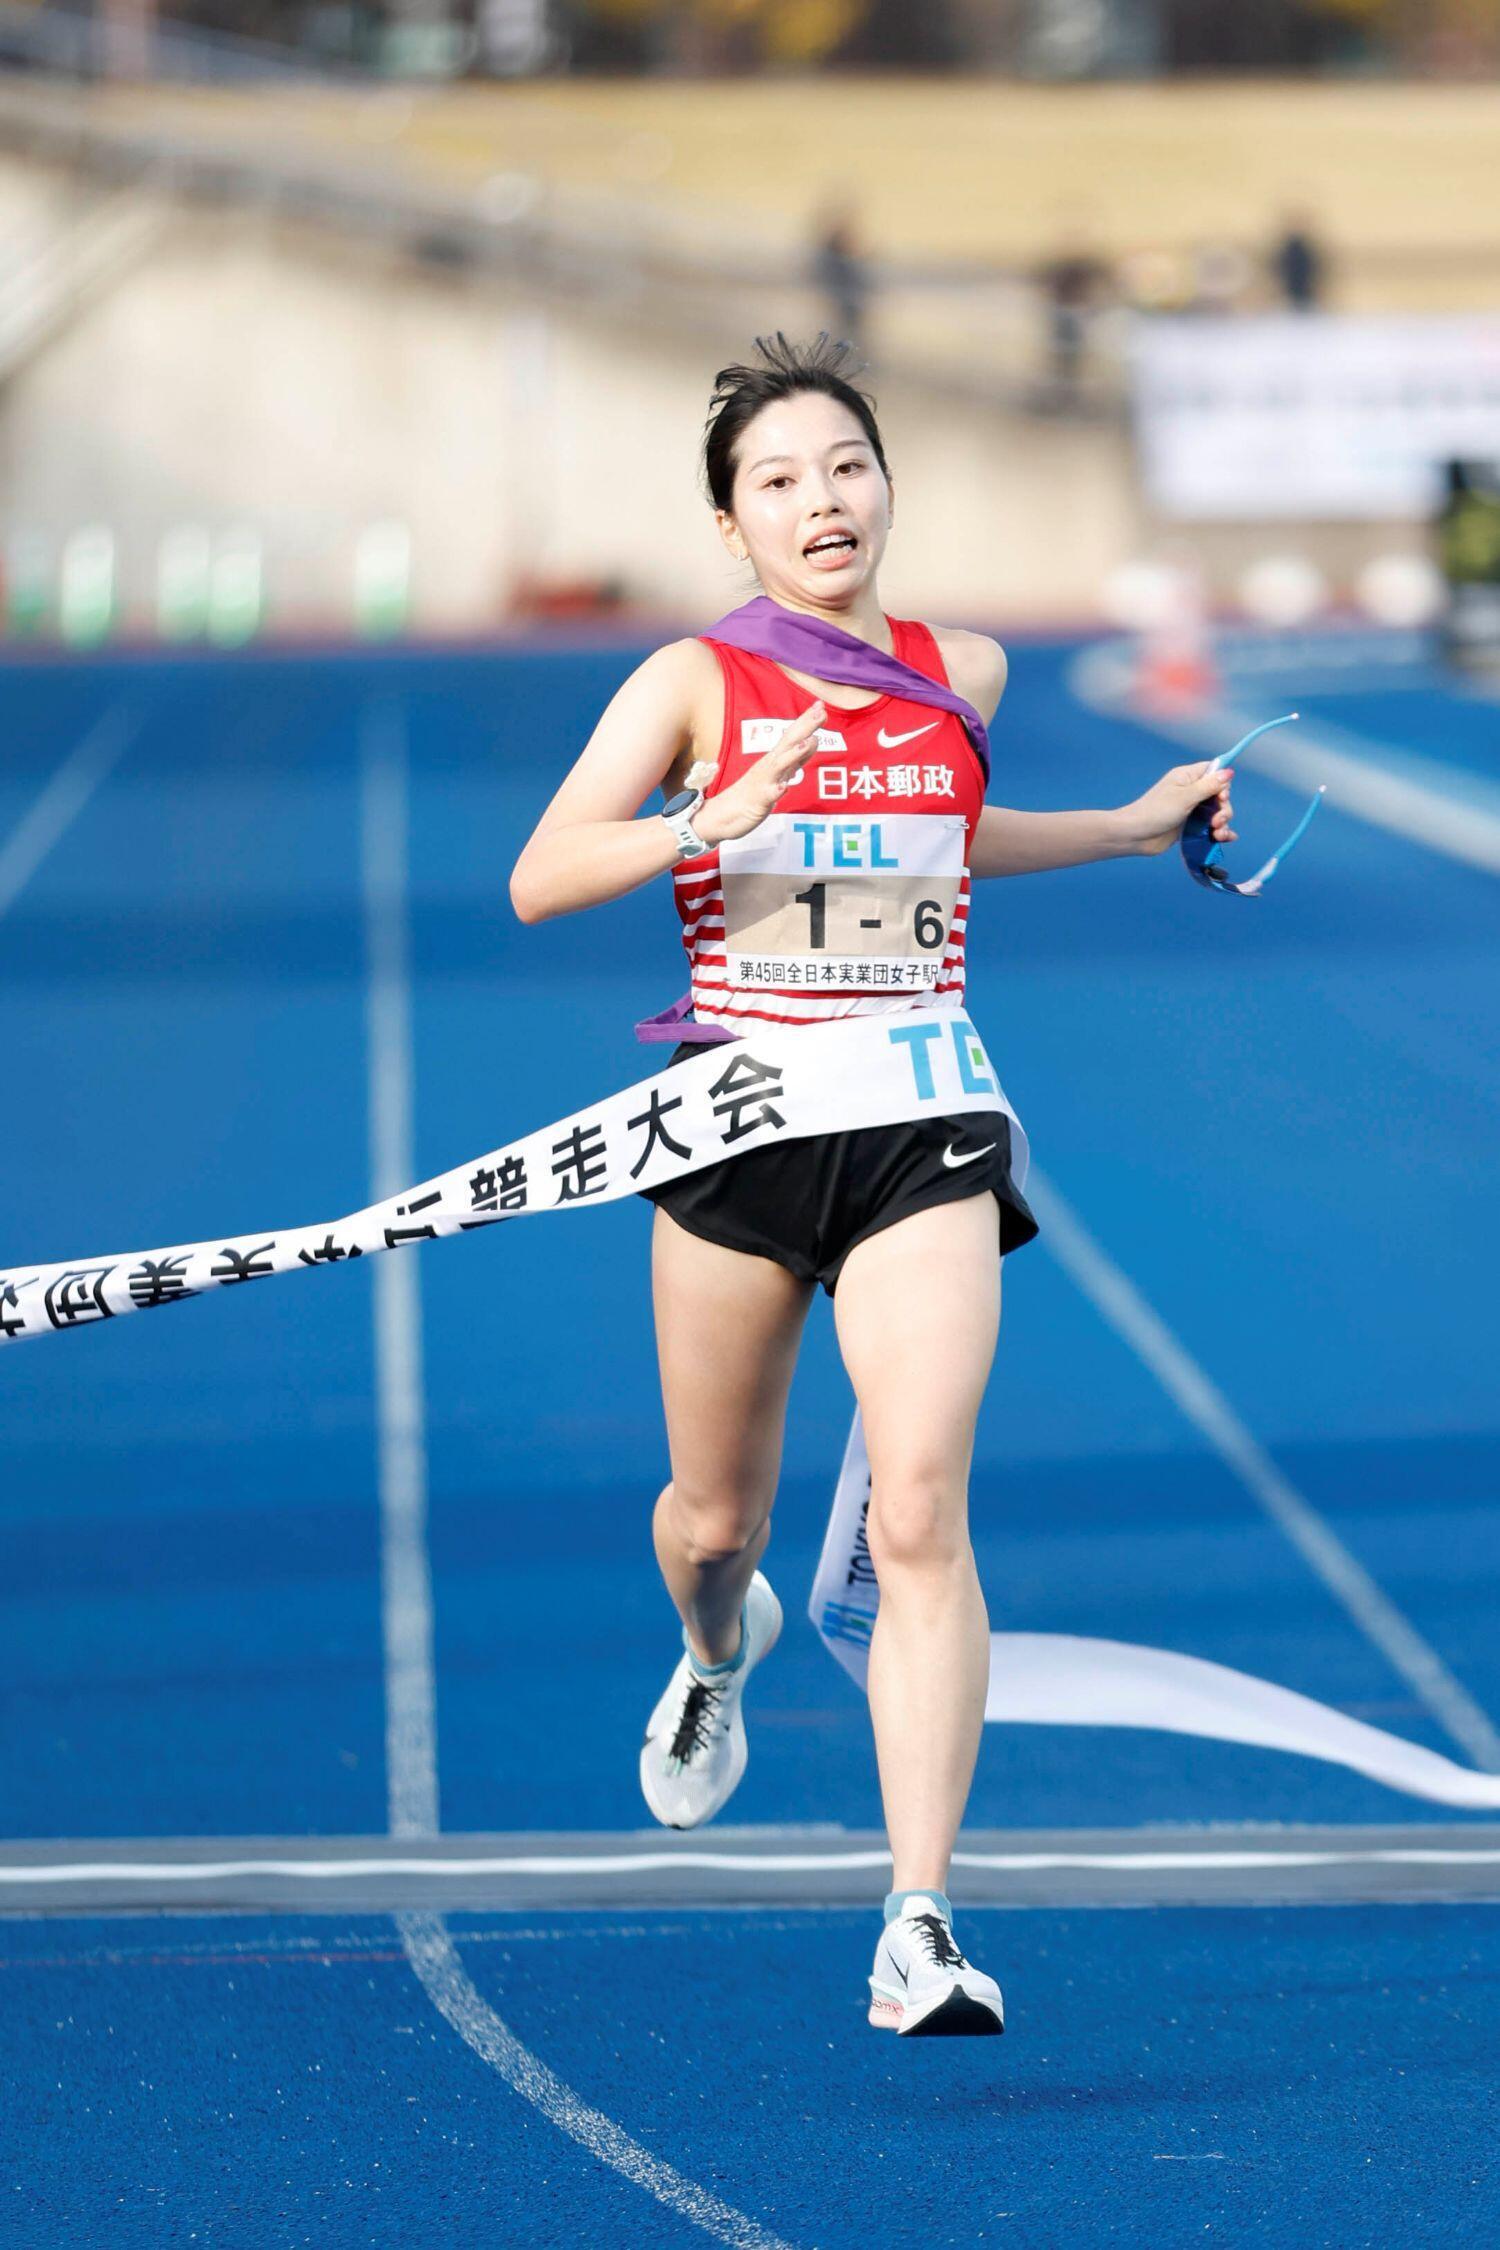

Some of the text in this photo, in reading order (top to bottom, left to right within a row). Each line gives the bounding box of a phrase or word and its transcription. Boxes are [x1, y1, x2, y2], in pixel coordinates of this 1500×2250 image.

[817, 764, 956, 800] 日本郵政
[793, 823, 899, 869] TEL
[795, 883, 826, 949] 1
[913, 900, 945, 950] 6
[739, 960, 939, 985] 第45回全日本実業団女子駅
[888, 1021, 996, 1101] TE
